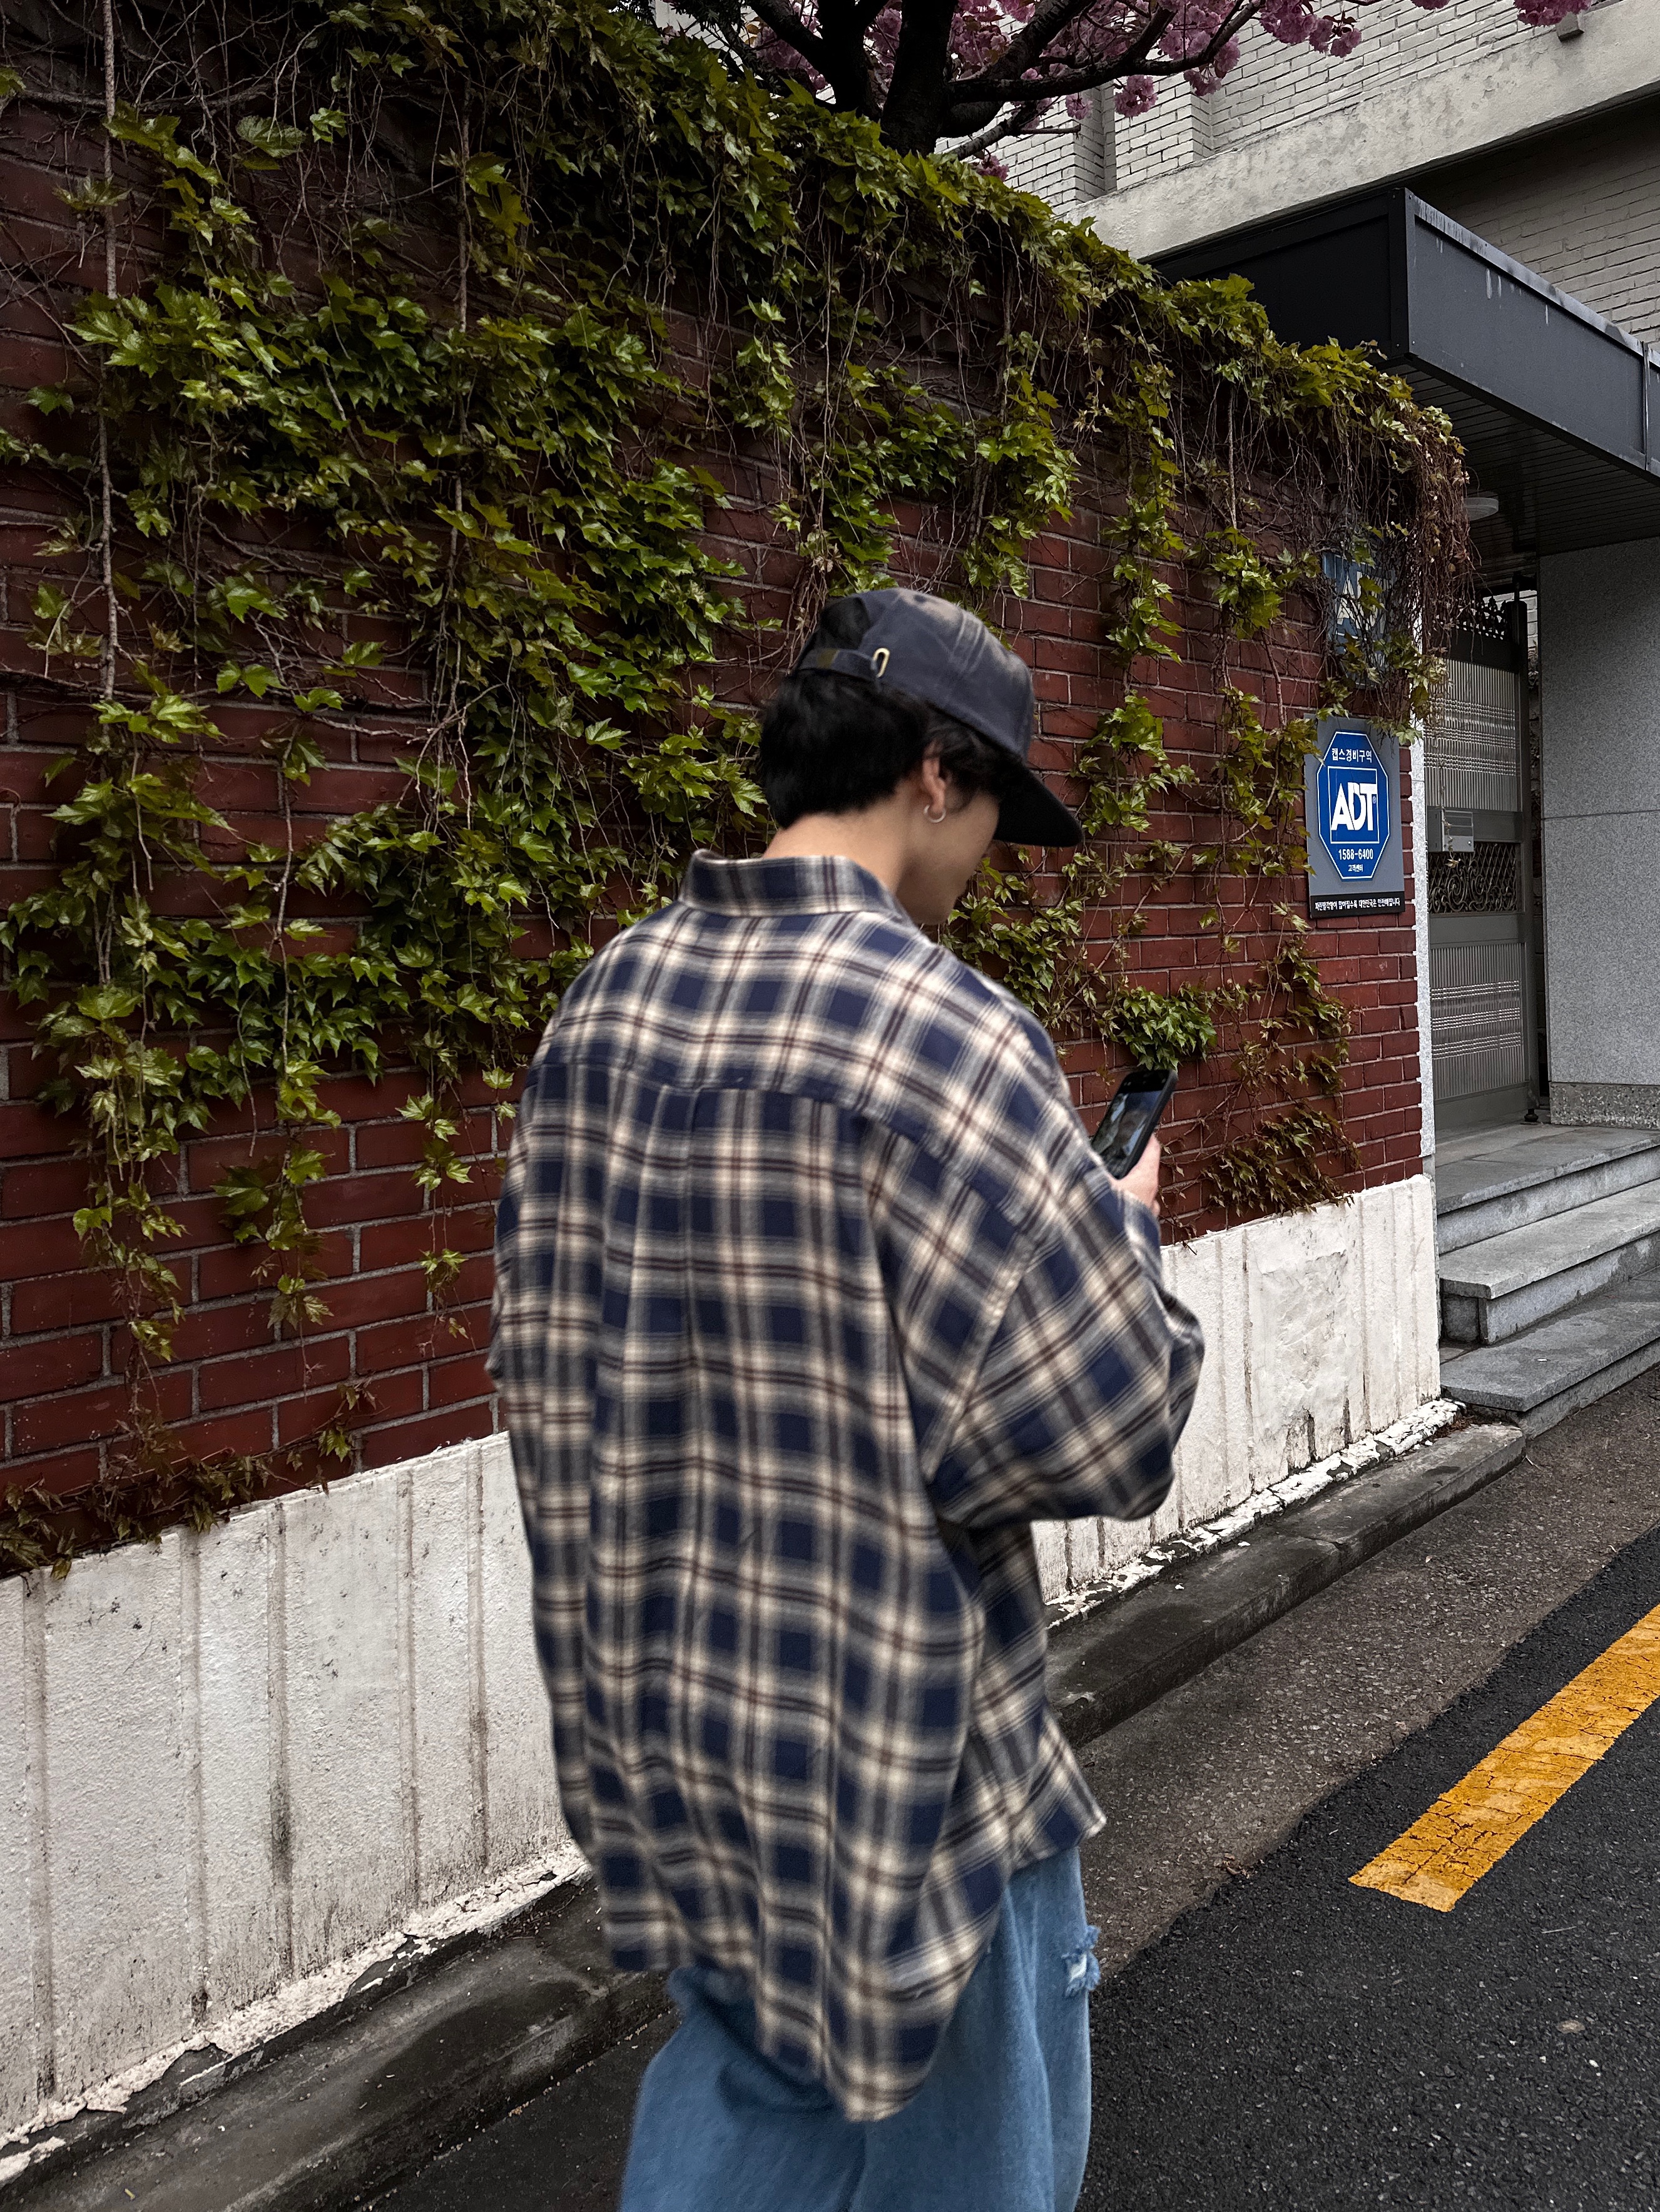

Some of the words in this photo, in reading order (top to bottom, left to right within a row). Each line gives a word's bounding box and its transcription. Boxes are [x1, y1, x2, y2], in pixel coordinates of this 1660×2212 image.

[1332, 748, 1372, 763] 캡스경비구역
[1331, 782, 1377, 831] ADT
[1338, 849, 1373, 860] 1588-6400
